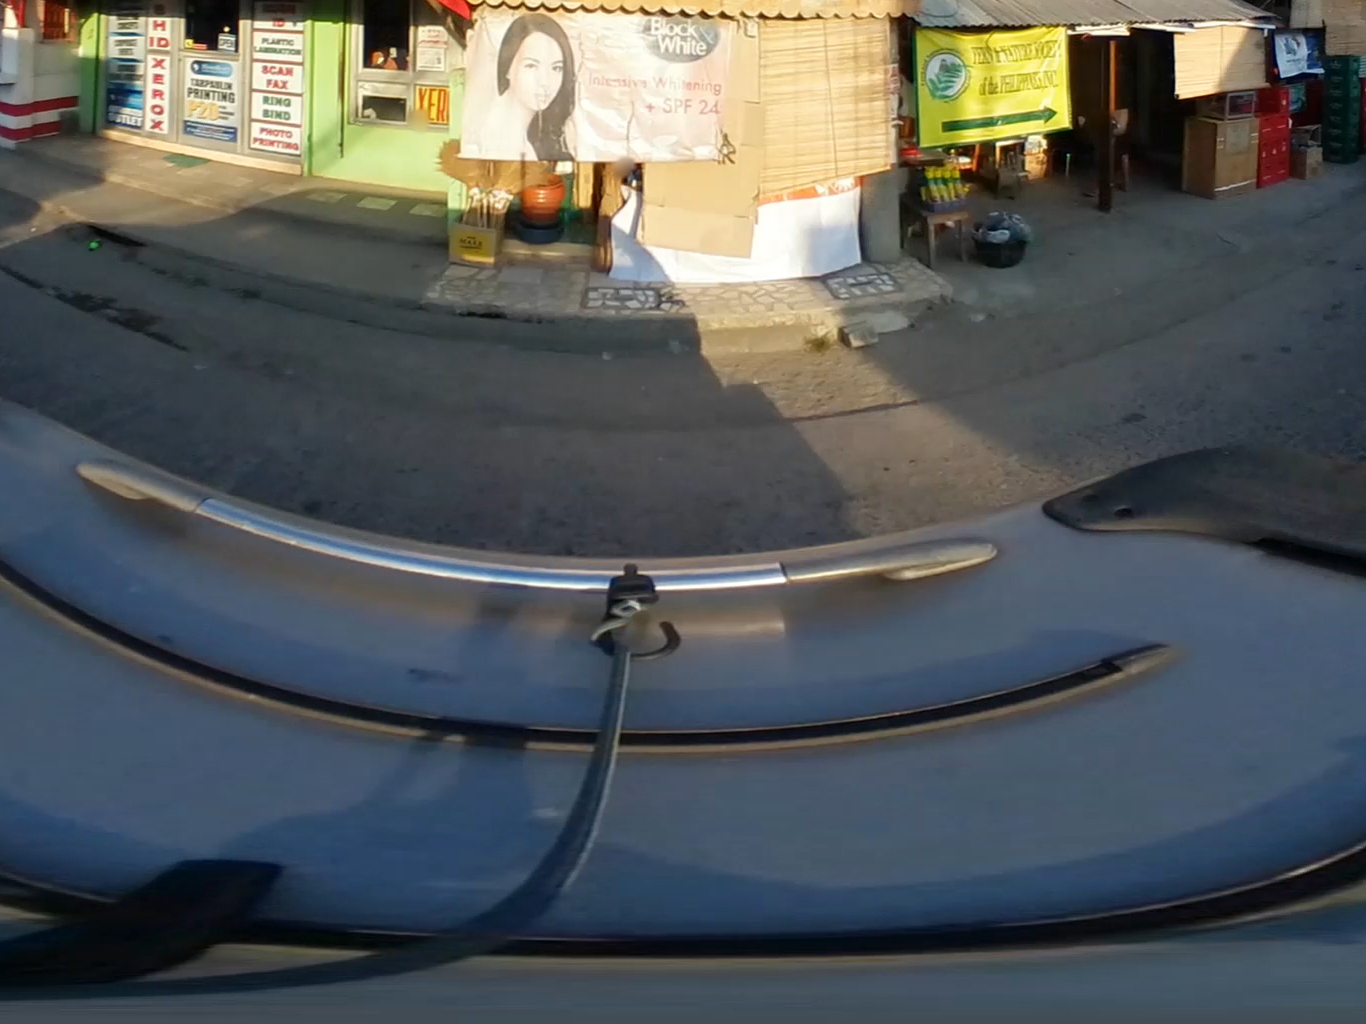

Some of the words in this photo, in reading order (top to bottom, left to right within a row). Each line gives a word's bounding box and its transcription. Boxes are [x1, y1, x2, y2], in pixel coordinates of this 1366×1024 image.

[650, 17, 699, 37] Block
[261, 37, 295, 47] PLASTIC
[657, 34, 708, 56] White
[261, 65, 294, 77] SCAN
[190, 78, 233, 91] TARPAULIN
[266, 79, 289, 90] FAX
[588, 72, 648, 89] Intensive
[653, 76, 723, 97] Whitening
[979, 77, 988, 96] of
[988, 76, 1000, 95] the
[149, 57, 167, 132] XEROX
[187, 87, 236, 104] PRINTING
[262, 95, 292, 108] RING
[262, 108, 291, 121] BIND
[662, 97, 693, 115] SPF
[698, 99, 722, 116] 24
[259, 127, 293, 139] PHOTO
[252, 136, 300, 152] PRINTING
